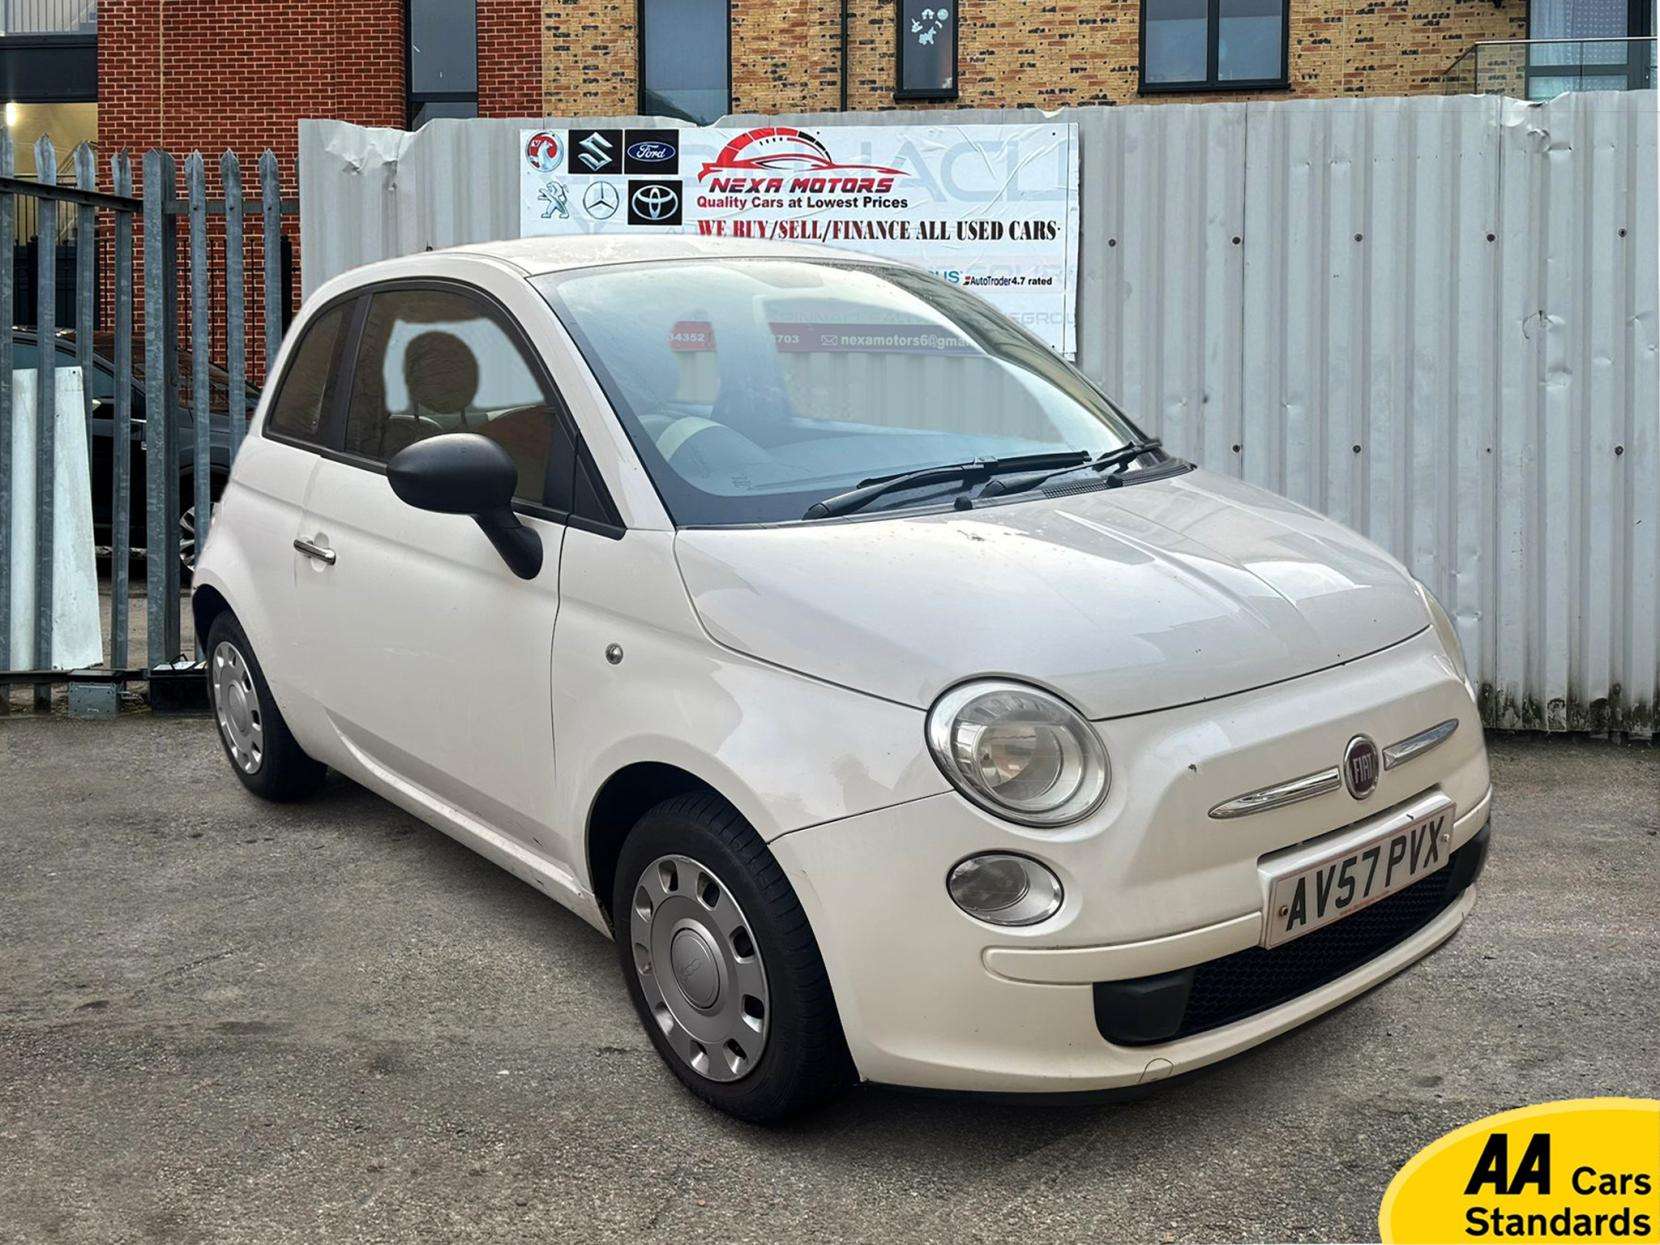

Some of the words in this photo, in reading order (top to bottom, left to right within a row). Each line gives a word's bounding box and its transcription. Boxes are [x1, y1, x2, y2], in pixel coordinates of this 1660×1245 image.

[636, 144, 666, 159] Ford
[708, 177, 784, 194] NEXA
[789, 177, 895, 194] MOTORS
[697, 196, 747, 211] Quality
[751, 196, 784, 208] Cars
[788, 197, 802, 208] at
[807, 196, 859, 208] Lowest
[863, 196, 908, 208] Prices
[697, 219, 727, 237] WE
[916, 221, 951, 240] ALL
[956, 220, 1003, 241] USED
[1008, 220, 1057, 241] CARS
[1028, 277, 1053, 286] rated
[1352, 754, 1374, 784] FIAT
